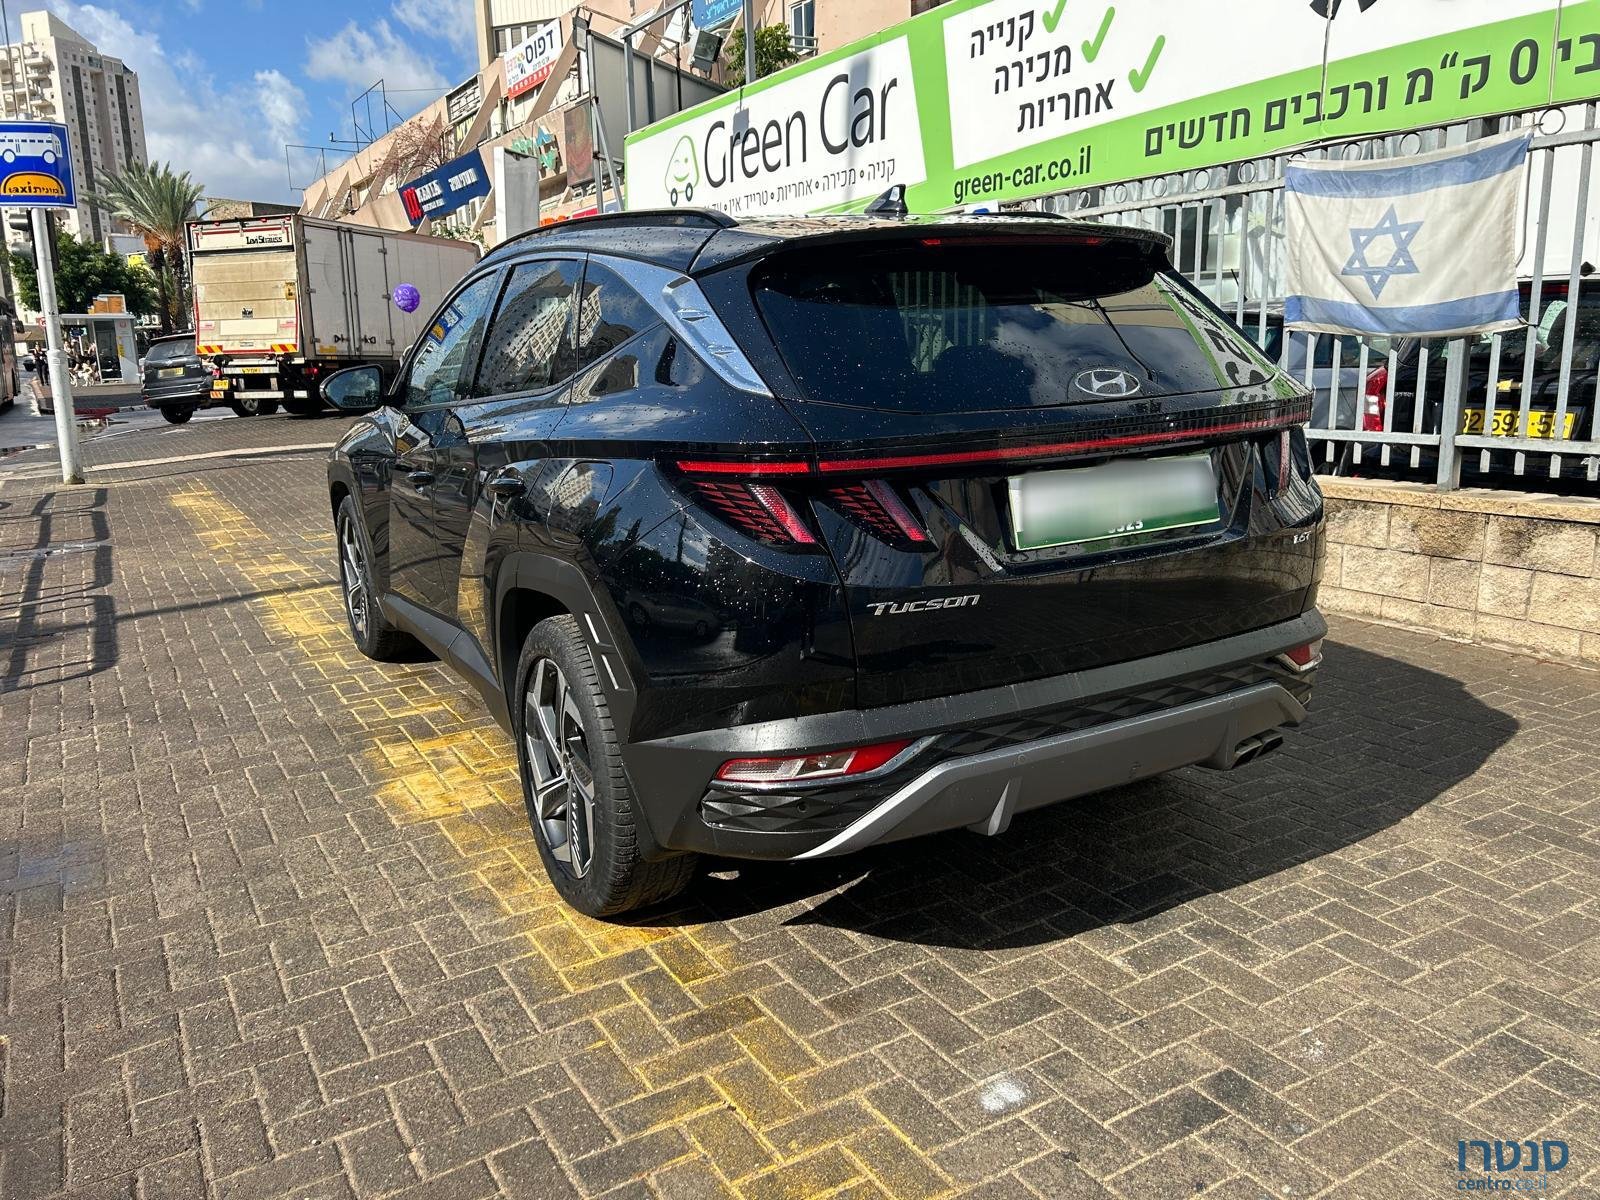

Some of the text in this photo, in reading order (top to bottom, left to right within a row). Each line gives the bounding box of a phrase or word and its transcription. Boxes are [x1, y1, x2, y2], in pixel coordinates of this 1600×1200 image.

[525, 29, 554, 64] דפוס
[970, 10, 1034, 59] קנייה
[994, 45, 1071, 94] מכירה
[1509, 38, 1539, 85] 0
[1017, 78, 1115, 133] אחריות
[1263, 76, 1389, 133] ורכבים
[704, 73, 897, 188] Green Car
[1145, 107, 1251, 157] חדשים
[8, 181, 32, 194] taxi
[33, 186, 59, 194] מונית
[729, 158, 895, 216] קניה מכירה אחריות טרייד אין
[954, 145, 1091, 204] green-car.co.il
